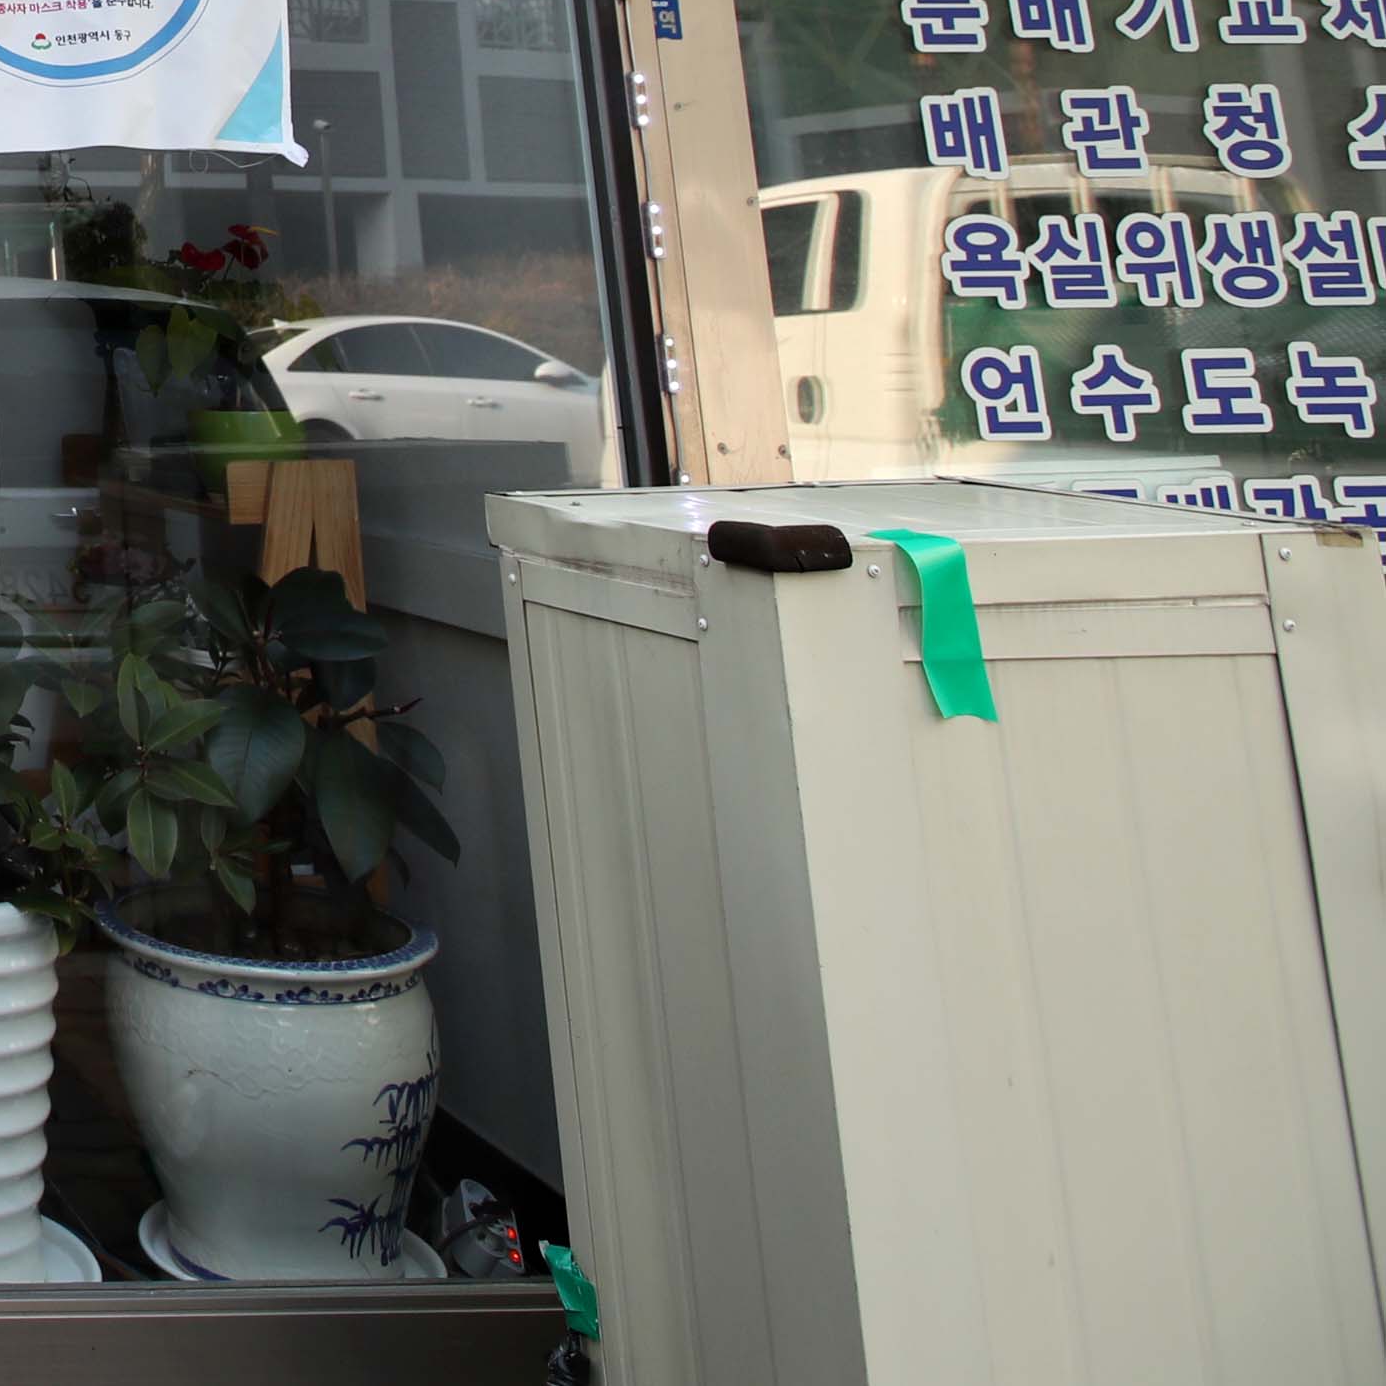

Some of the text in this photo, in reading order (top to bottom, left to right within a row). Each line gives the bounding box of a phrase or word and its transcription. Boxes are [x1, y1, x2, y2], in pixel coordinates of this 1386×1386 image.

[29, 1, 62, 14] 마스크
[55, 29, 132, 47] 인천광역시 동구
[946, 214, 1386, 304] 욕실위생설
